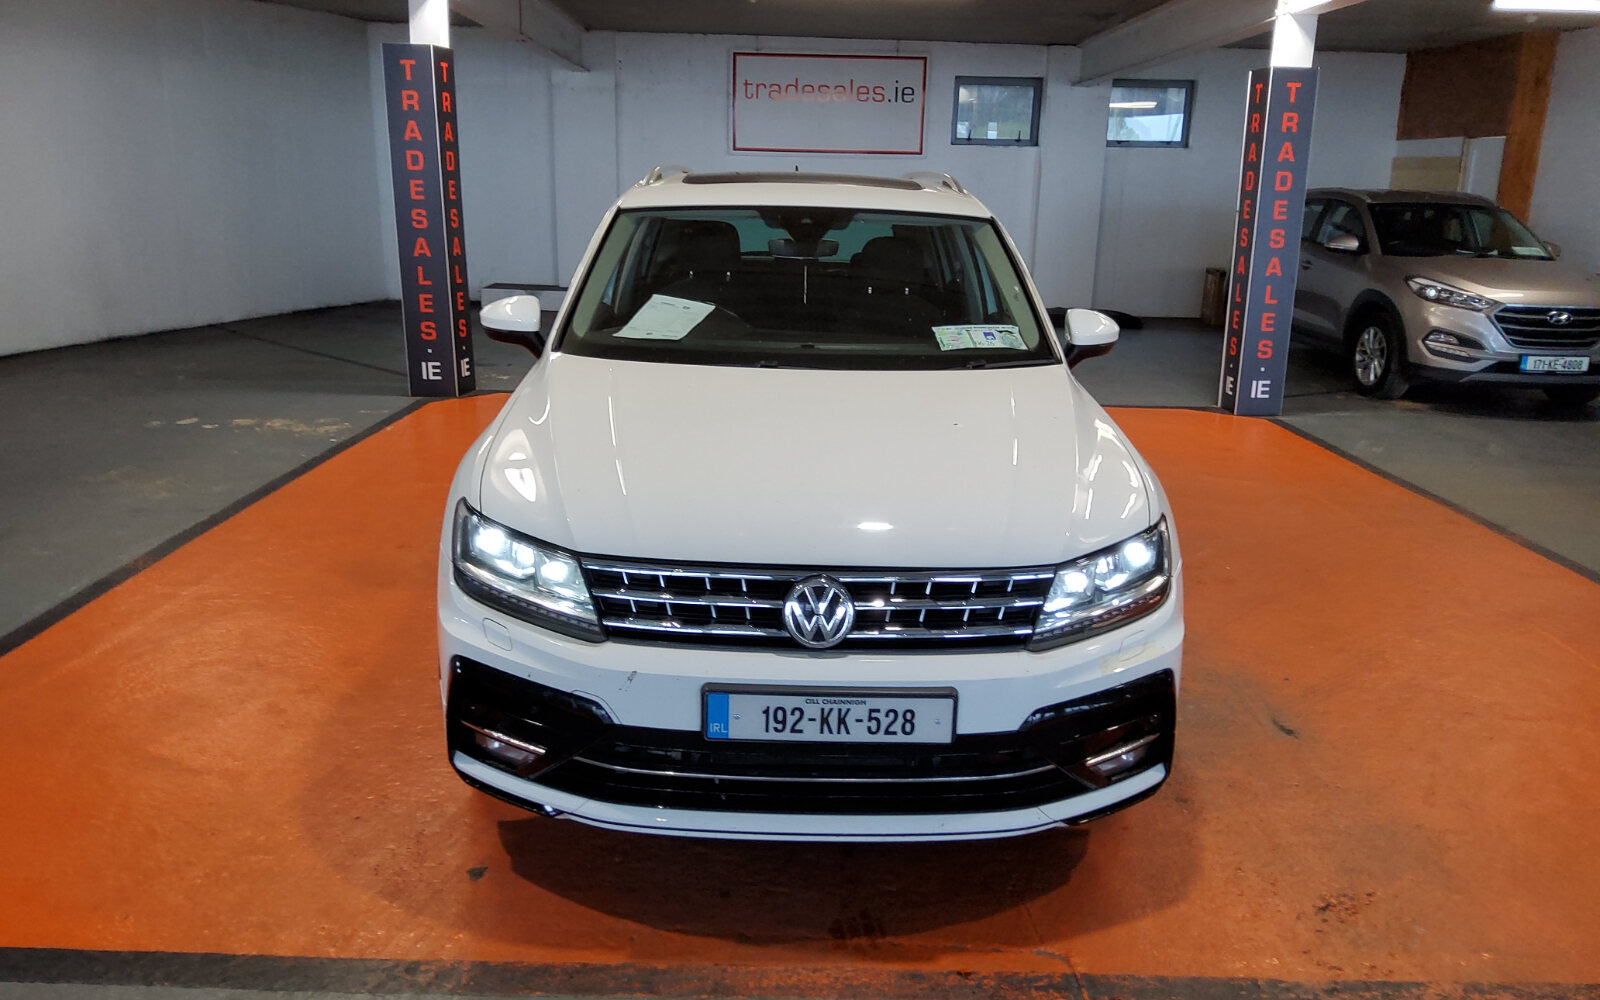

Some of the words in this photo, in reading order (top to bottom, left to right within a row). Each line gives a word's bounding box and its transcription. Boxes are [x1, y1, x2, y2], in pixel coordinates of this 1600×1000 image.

[743, 78, 915, 103] tradesales.ie
[709, 723, 728, 734] IRL
[762, 705, 916, 736] 192-KK-528
